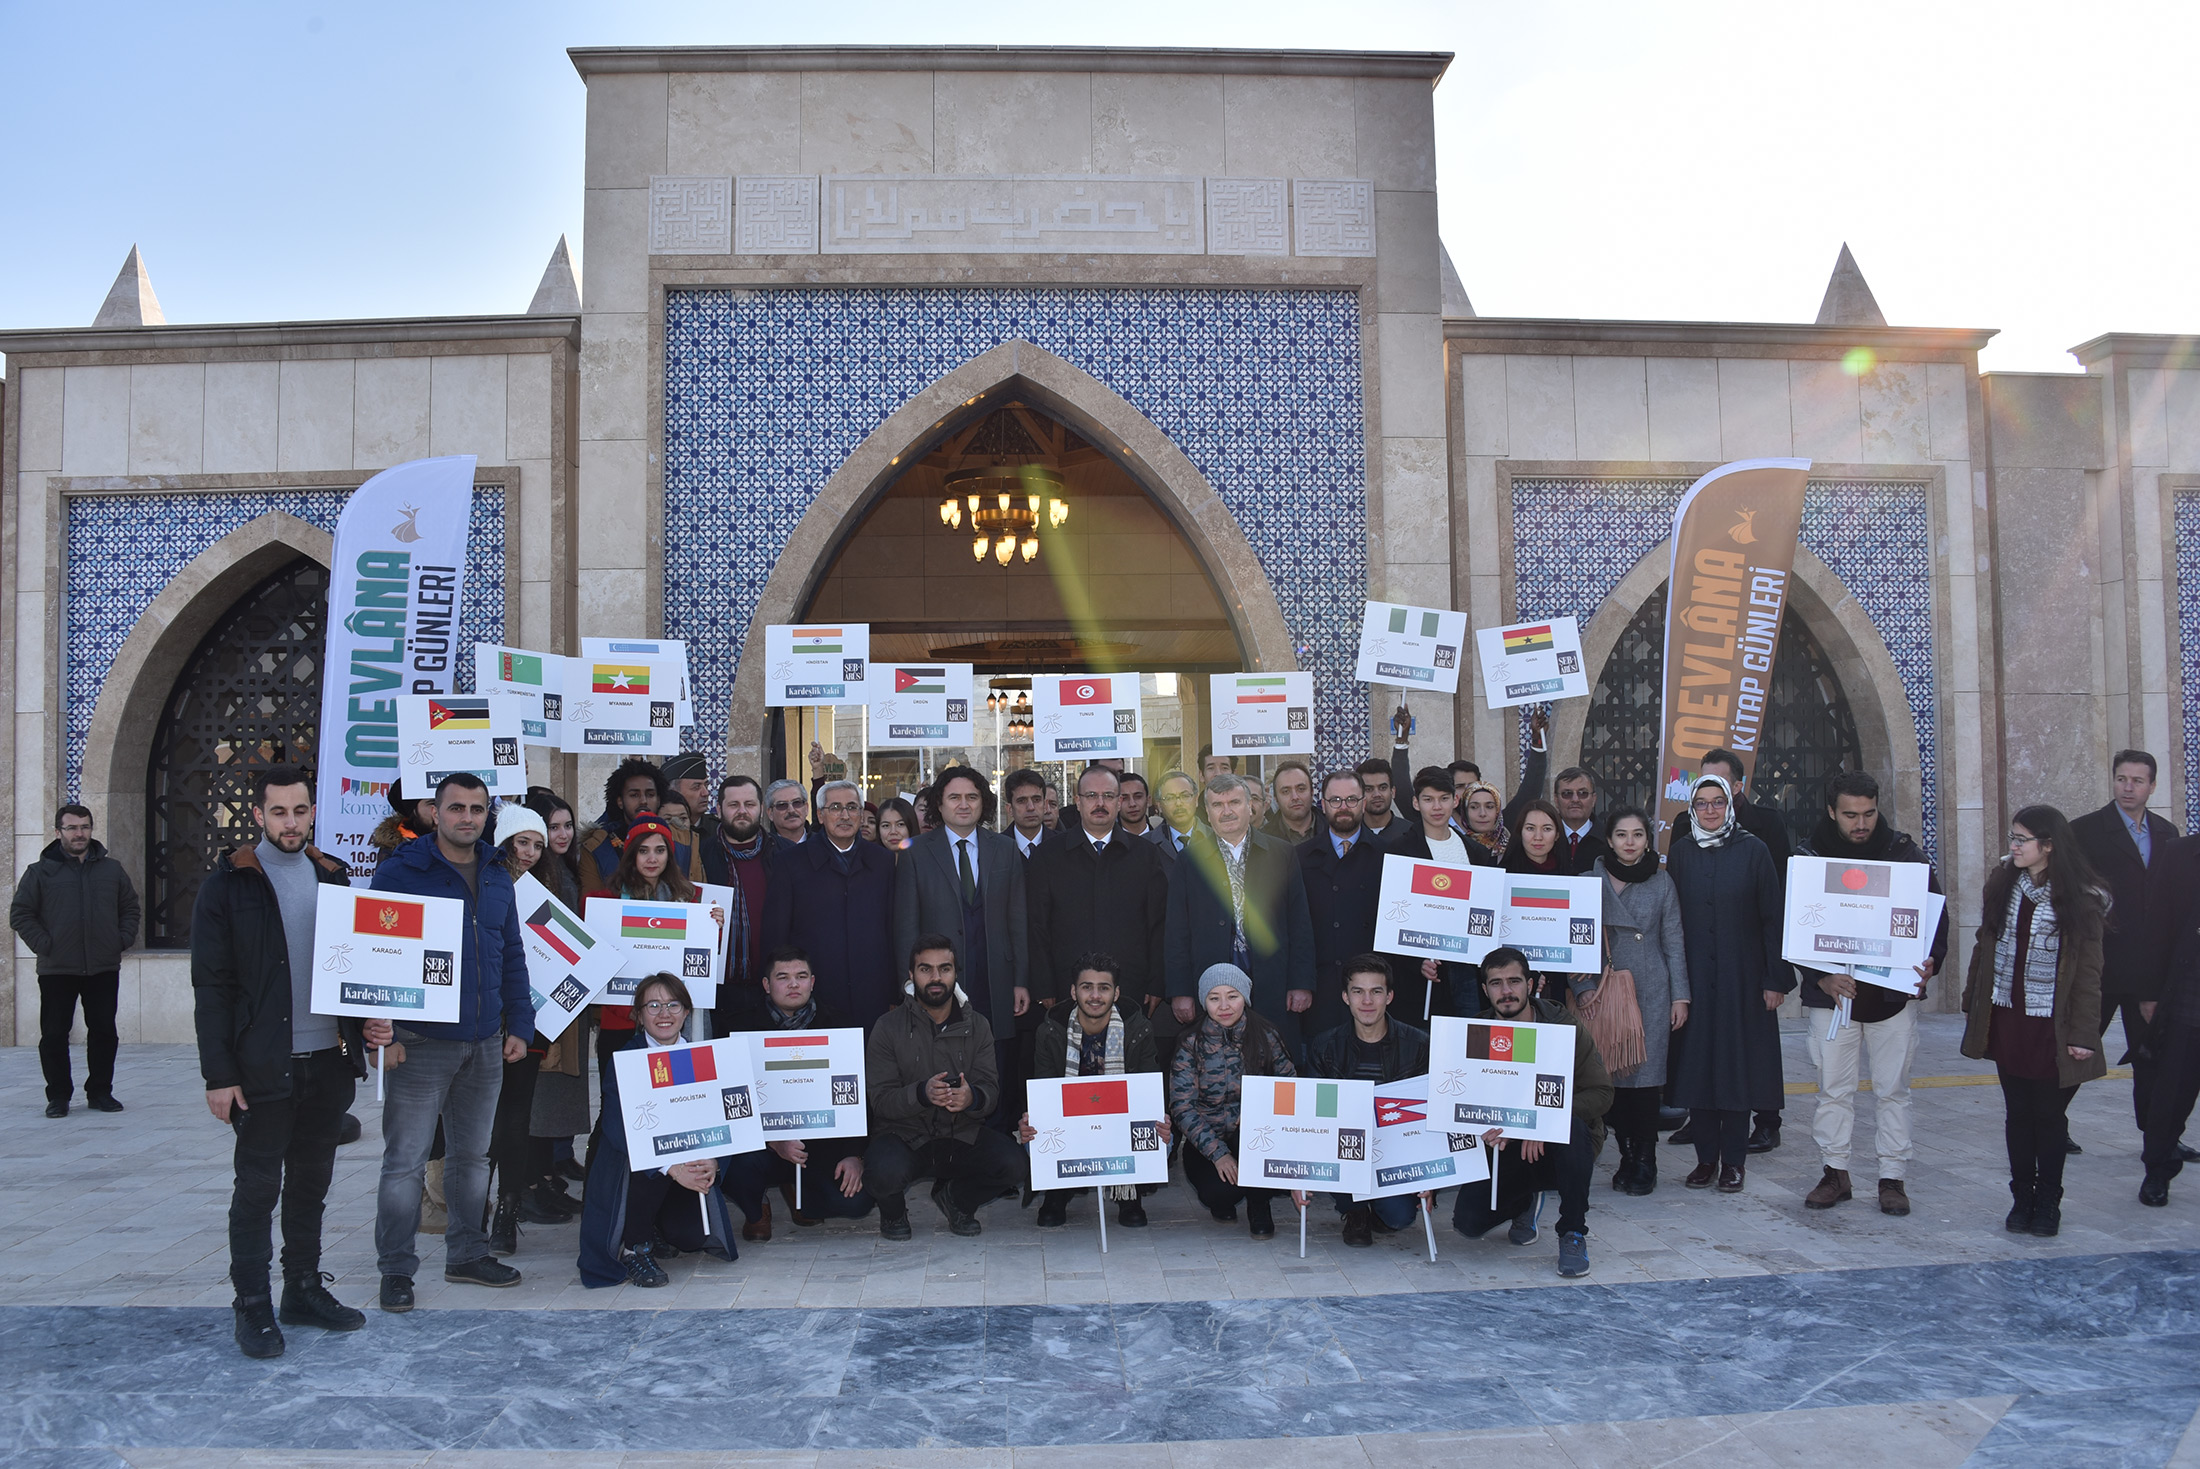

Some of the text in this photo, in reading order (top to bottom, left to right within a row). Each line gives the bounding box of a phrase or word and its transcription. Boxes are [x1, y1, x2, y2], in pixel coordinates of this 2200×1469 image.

[407, 565, 456, 672] GÜNLERİ
[344, 550, 411, 768] MEVLÂNA
[1672, 549, 1745, 760] MEVLÂNA
[1730, 566, 1786, 751] KİTAP GÜNLERİ
[1379, 665, 1430, 679] Kardeşlik Vakti
[788, 686, 840, 697] Kardeşlik Vakti
[1508, 681, 1558, 695] Kardeşlik Vakti
[587, 732, 646, 743] Kardeşlik Vakti
[892, 727, 943, 737] Kardeşlik Vakti
[1058, 738, 1112, 751] Kardeşlik Vakti
[1235, 735, 1285, 746] Kardeşlik Vakti
[335, 833, 364, 845] 7-17
[350, 851, 377, 863] 10:0
[1840, 902, 1874, 910] BANGLADEŞ
[1402, 933, 1462, 949] Kardeşlik Vakti
[1818, 938, 1884, 953] Kardeşlik Vakti
[372, 947, 402, 955] KARADAĞ
[532, 945, 551, 963] KUVEYT
[1546, 949, 1565, 959] Vakti
[611, 981, 638, 992] Karde
[345, 987, 417, 1003] Kardeşlik Vakti
[1481, 1068, 1519, 1076] AFGANİSTAN
[669, 1093, 707, 1103] MOĞOLİSTAN
[763, 1113, 828, 1128] Kardeşlik Vakti
[1459, 1107, 1529, 1124] Kardeşlik Vakti
[657, 1129, 724, 1151] Kardeşlik Vakti
[1061, 1160, 1128, 1174] Kardeşlik Vakti
[1268, 1162, 1333, 1177] Kardeşlik Vakti
[1380, 1162, 1448, 1184] Kardeşlik Vakti
